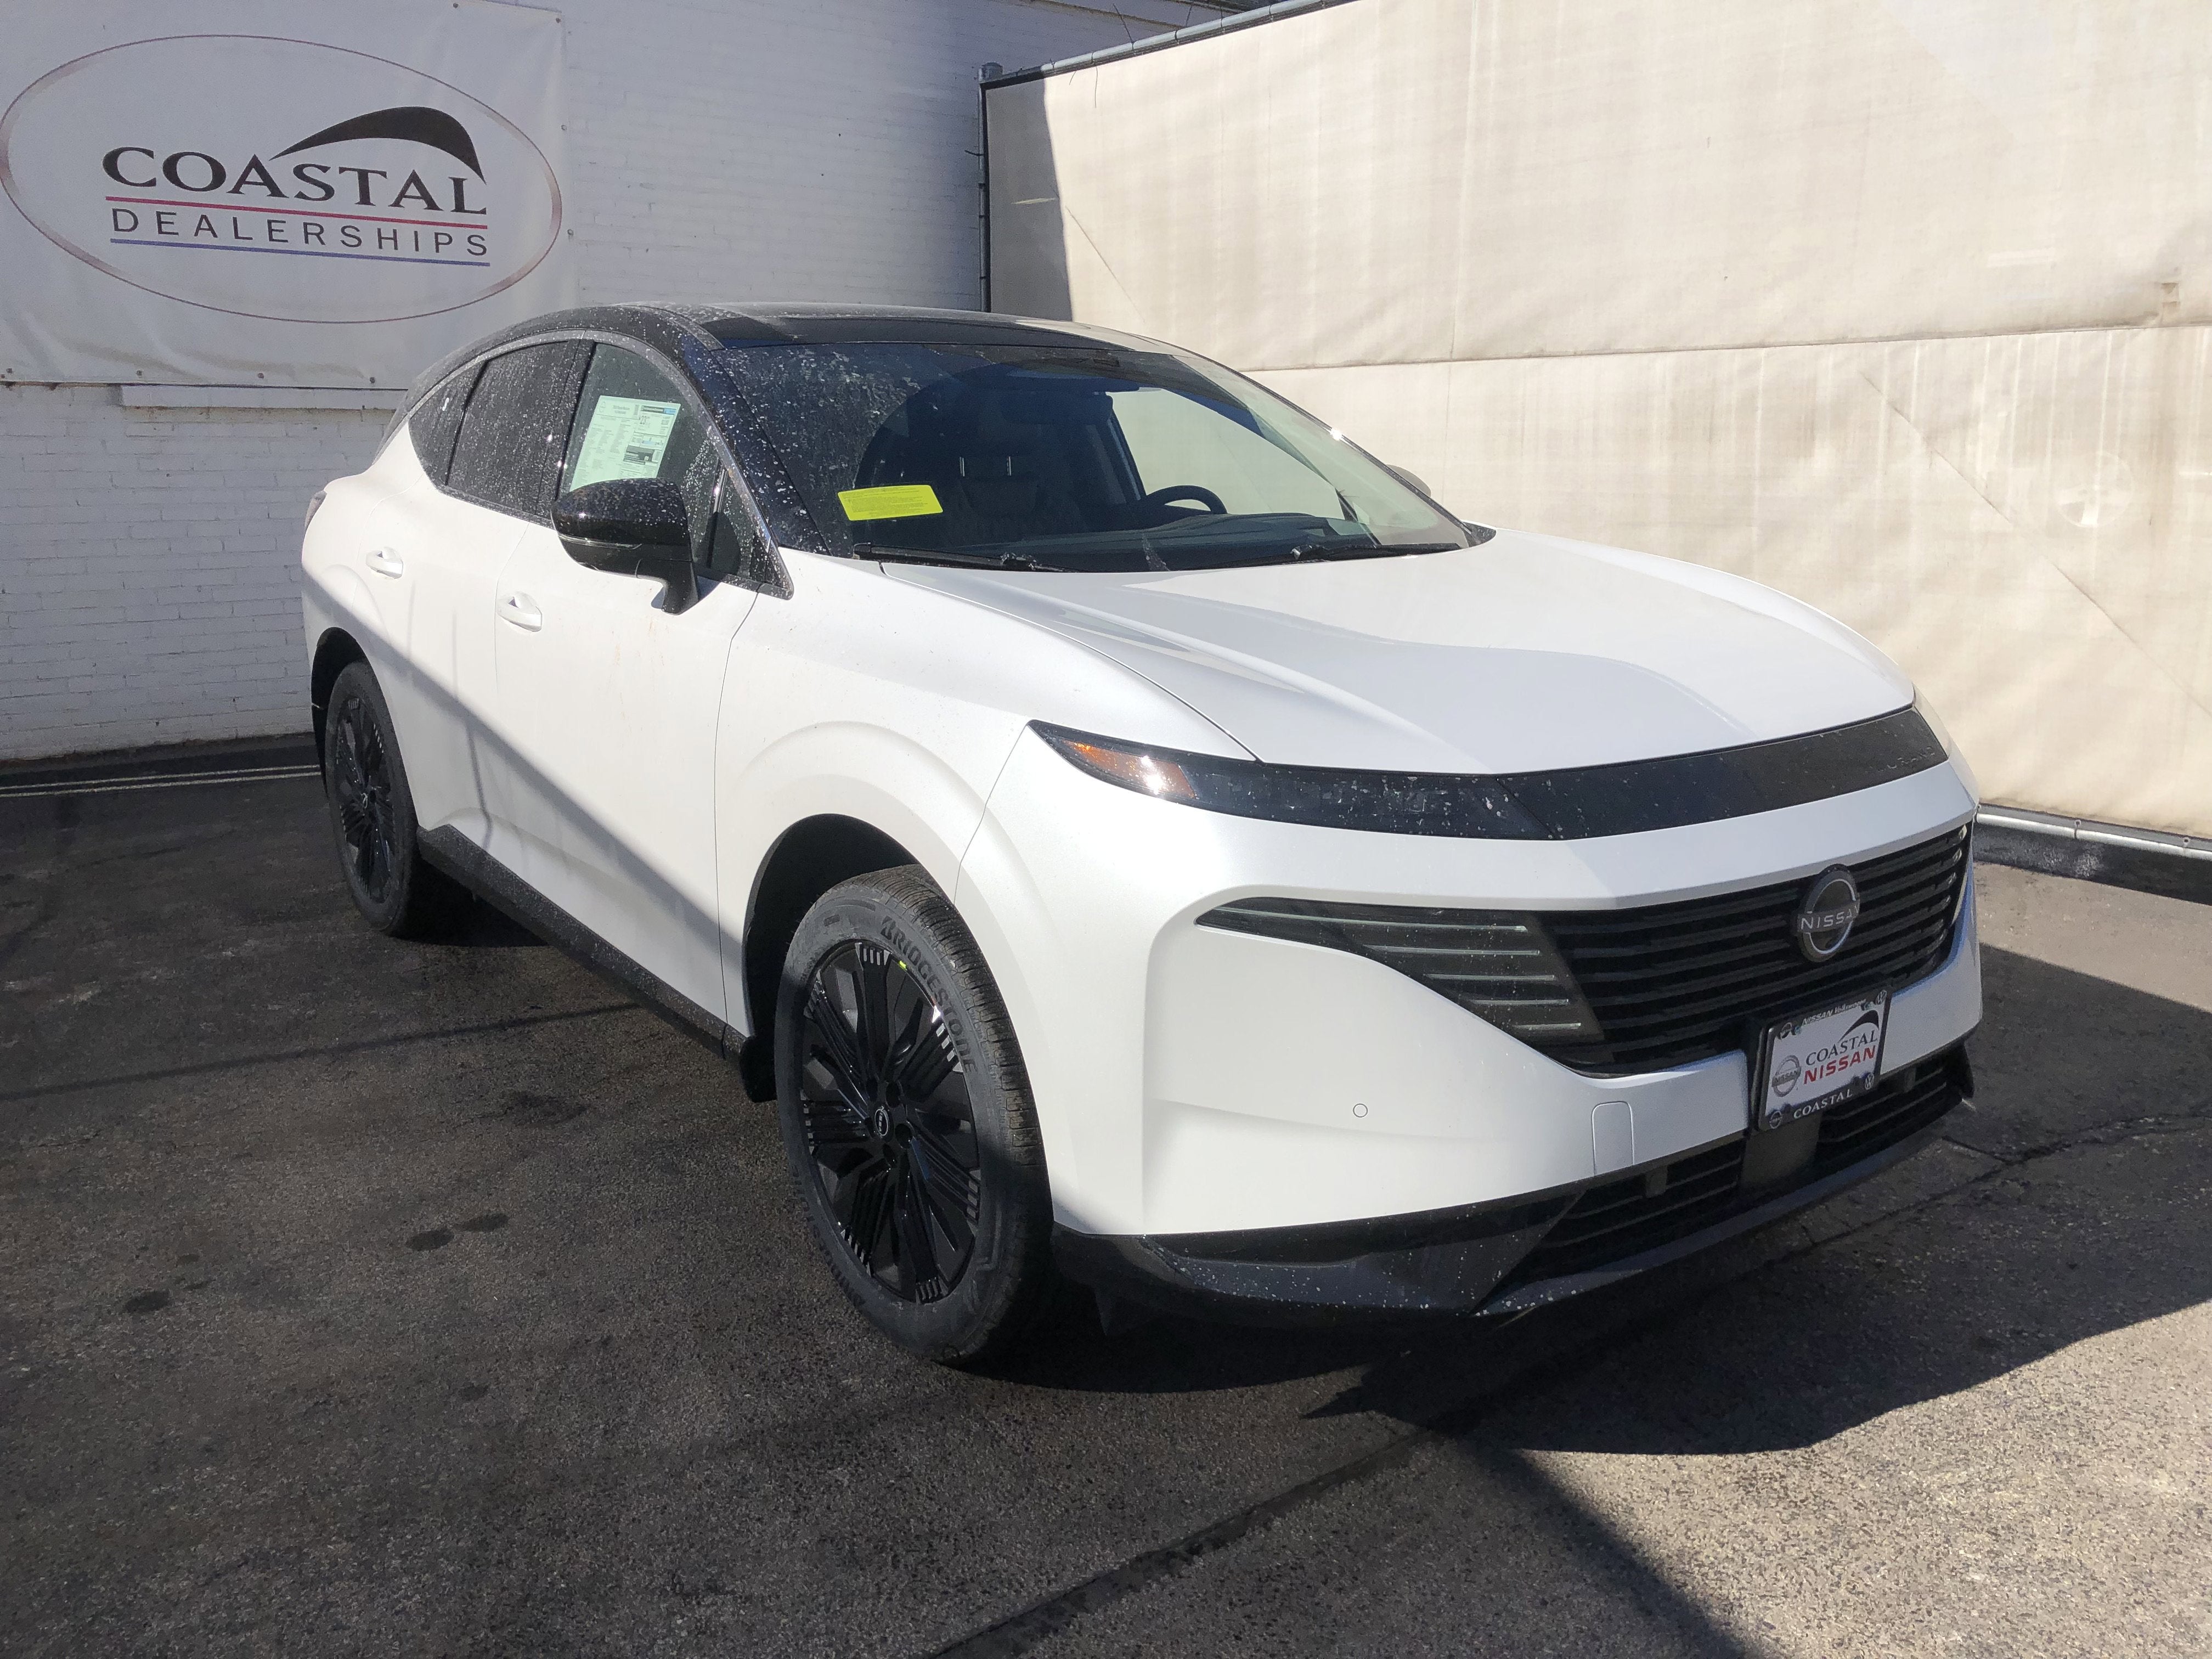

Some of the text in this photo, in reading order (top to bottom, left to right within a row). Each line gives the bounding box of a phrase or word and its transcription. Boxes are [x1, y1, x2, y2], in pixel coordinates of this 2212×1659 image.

[102, 146, 487, 216] COASTAL
[112, 207, 487, 257] DEALERSHIPS
[880, 915, 978, 1072] BRIDGESTONE
[1801, 1009, 1833, 1025] NISSAN
[1803, 1044, 1876, 1085] NISSAN
[1805, 1030, 1878, 1066] COASTAL
[1774, 1069, 1799, 1085] NISSAN
[1793, 1088, 1853, 1120] COASTAL
